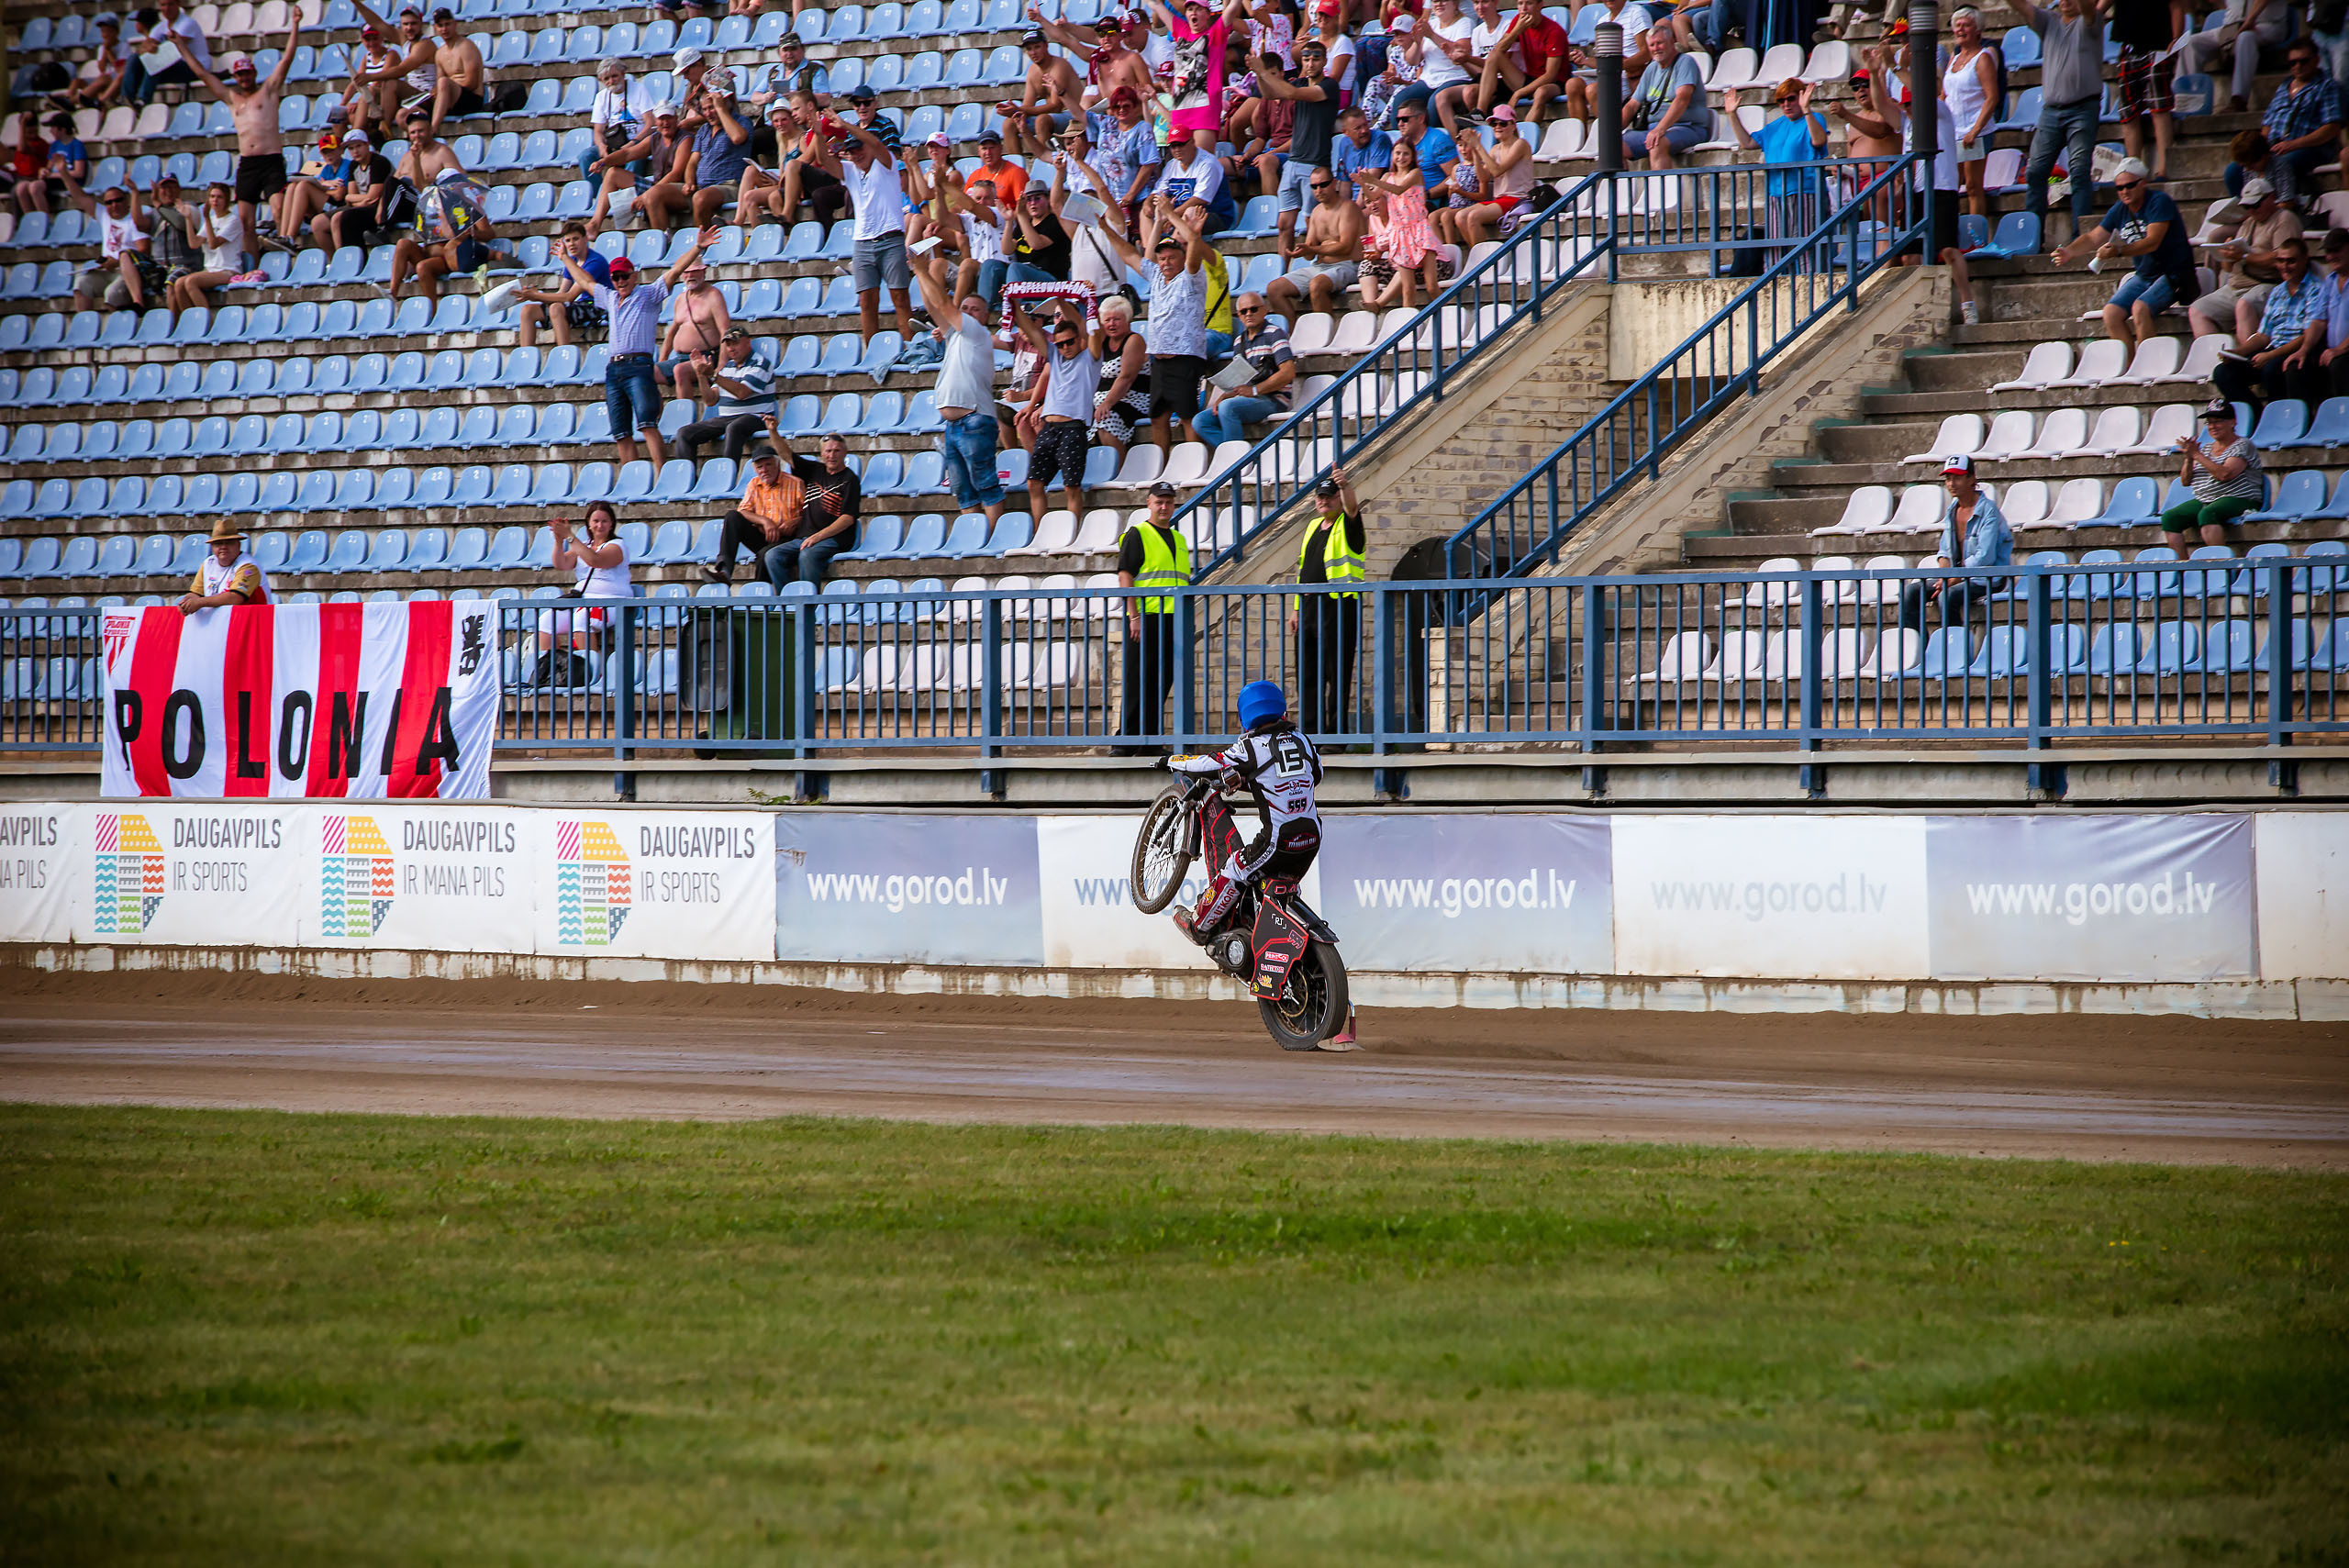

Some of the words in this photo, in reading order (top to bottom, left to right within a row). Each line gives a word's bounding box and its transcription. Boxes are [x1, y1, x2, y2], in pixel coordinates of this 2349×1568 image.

[115, 687, 459, 781] POLONIA
[1278, 748, 1304, 773] 15
[173, 817, 282, 849] DAUGAVPILS
[404, 820, 516, 852] DAUGAVPILS
[640, 827, 755, 858] DAUGAVPILS
[0, 860, 12, 888] A
[17, 860, 47, 888] PILS
[173, 862, 186, 892] IR
[193, 862, 248, 892] SPORTS
[404, 865, 417, 895] IR
[425, 865, 469, 895] MANA
[473, 866, 504, 896] PILS
[640, 872, 655, 902] IR
[661, 872, 720, 903] SPORTS
[807, 867, 1008, 913] www.gorod.lv
[1353, 869, 1576, 918] www.gorod.lv
[1651, 873, 1886, 921] www.gorod.lv
[1966, 872, 2217, 926] www.gorod.lv
